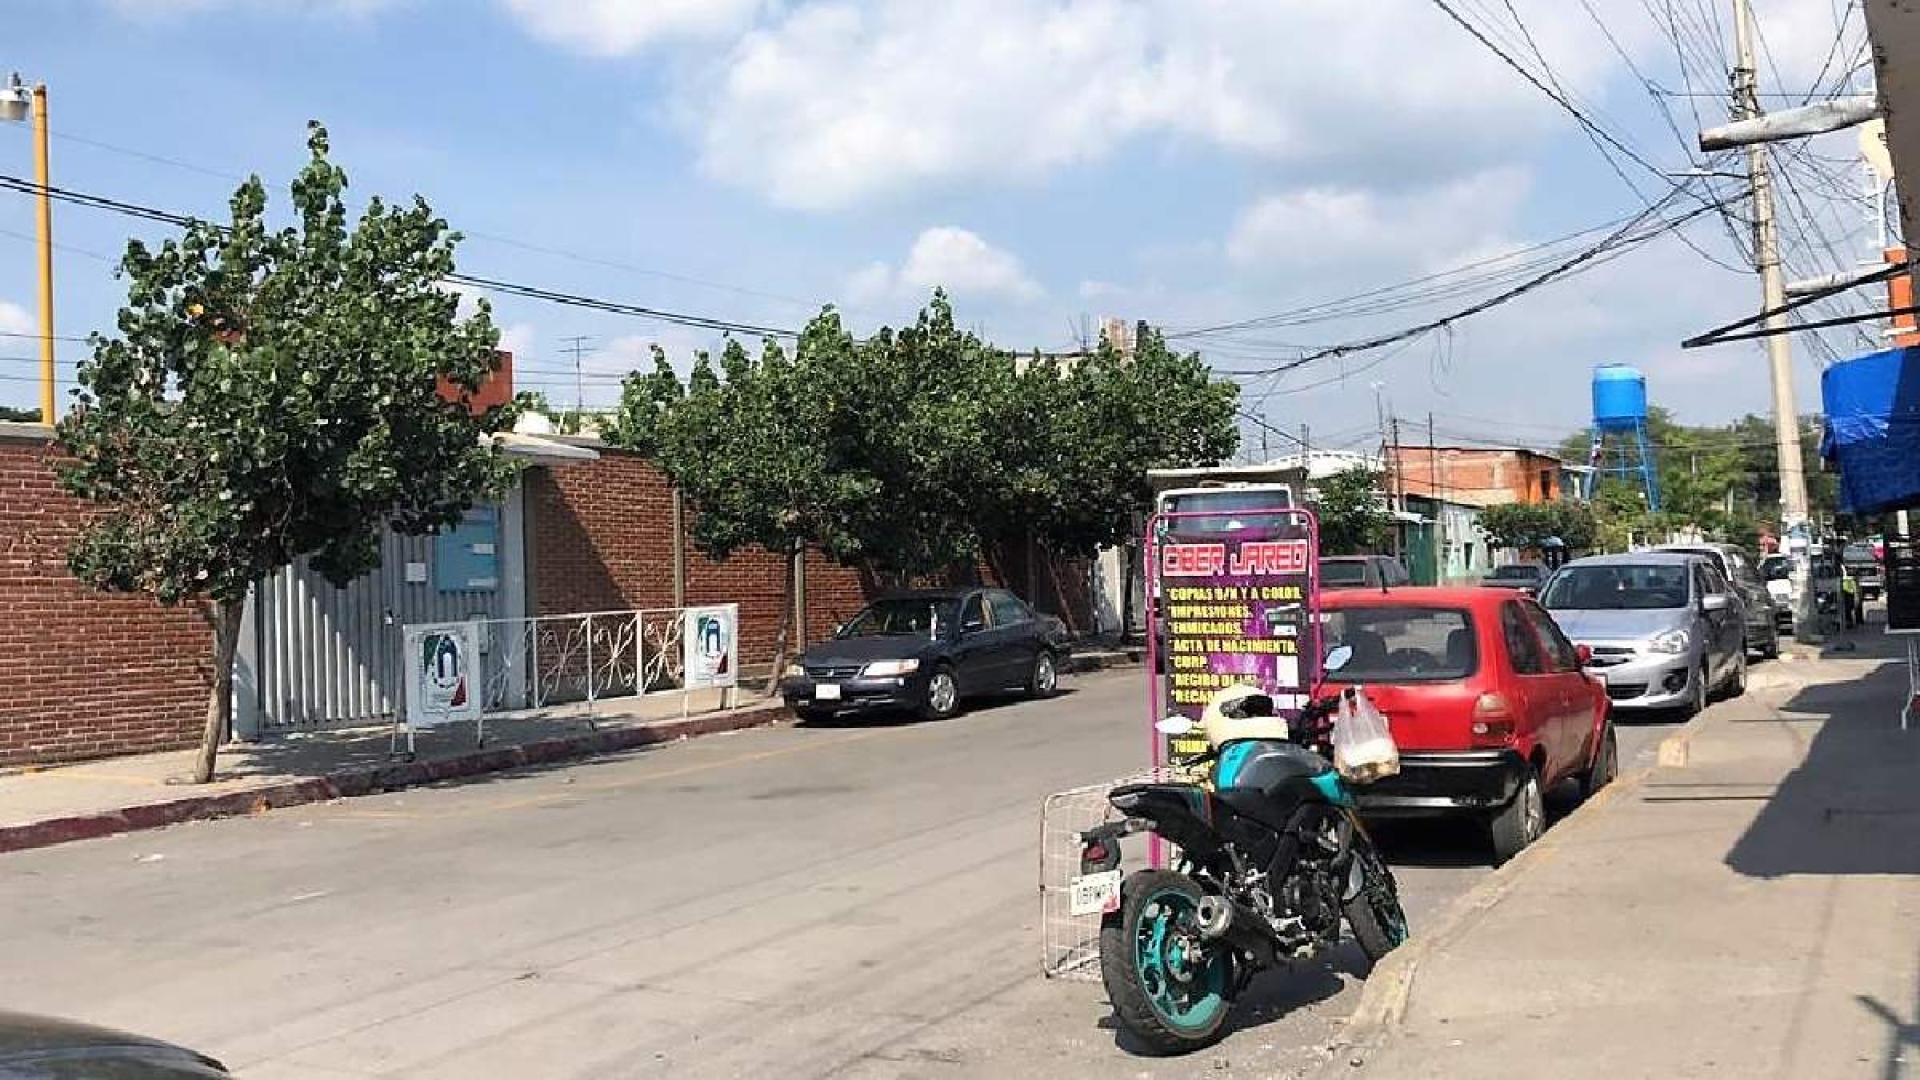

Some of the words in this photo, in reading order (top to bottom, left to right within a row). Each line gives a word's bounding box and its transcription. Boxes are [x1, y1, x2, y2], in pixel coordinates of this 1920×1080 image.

[1230, 539, 1308, 575] JARED
[1241, 586, 1248, 600] Y
[1251, 586, 1259, 600] A
[1174, 639, 1204, 653] ACTA
[1206, 639, 1221, 653] DE
[1176, 673, 1220, 687] RECIBO
